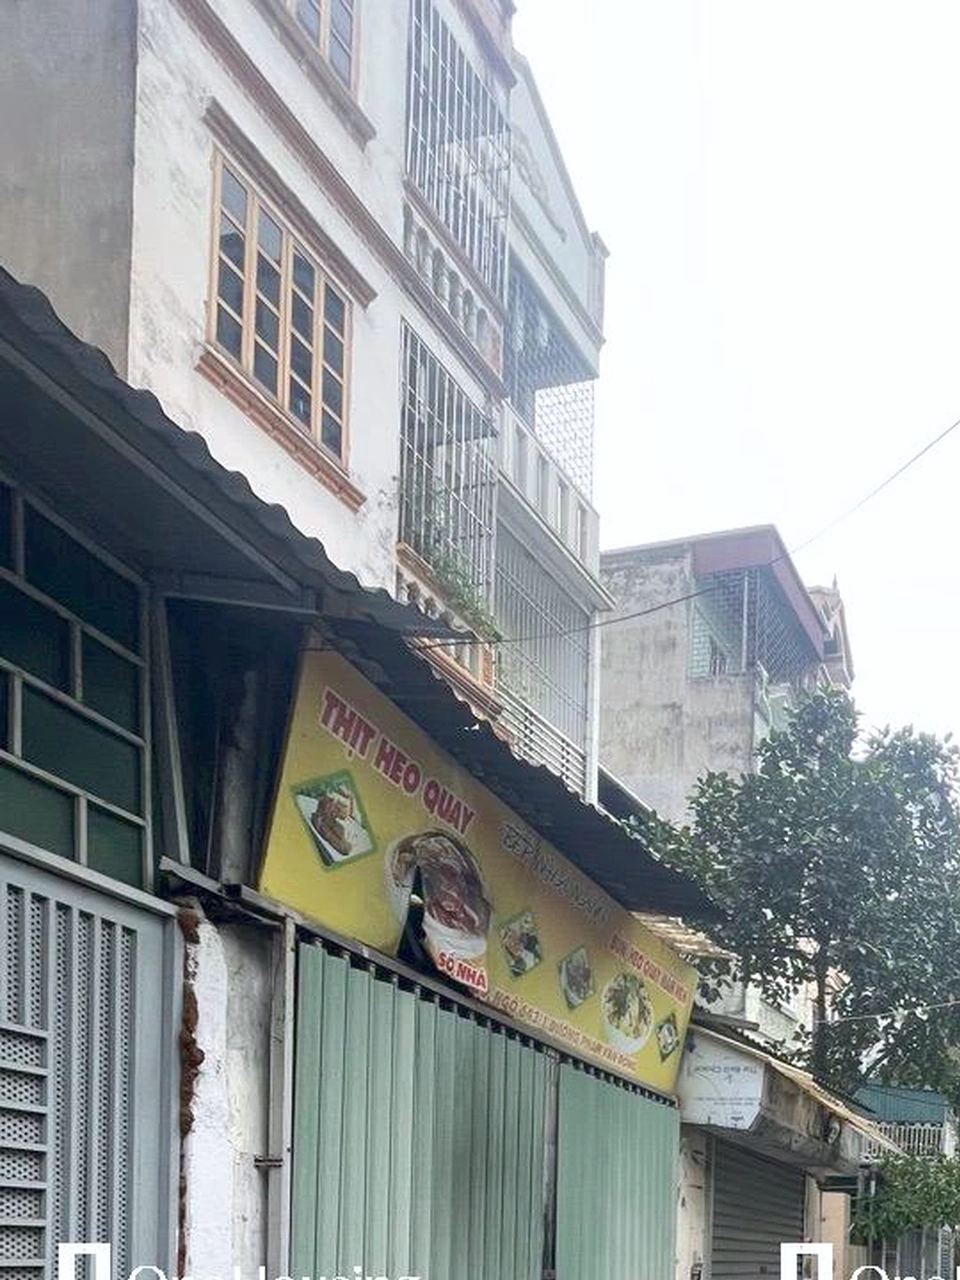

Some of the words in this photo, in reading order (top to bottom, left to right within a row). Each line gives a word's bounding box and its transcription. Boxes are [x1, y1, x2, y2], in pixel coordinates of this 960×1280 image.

[320, 687, 380, 761] THỊT
[372, 733, 423, 798] HEO
[422, 778, 477, 836] QUAY
[455, 961, 488, 991] NHÀ
